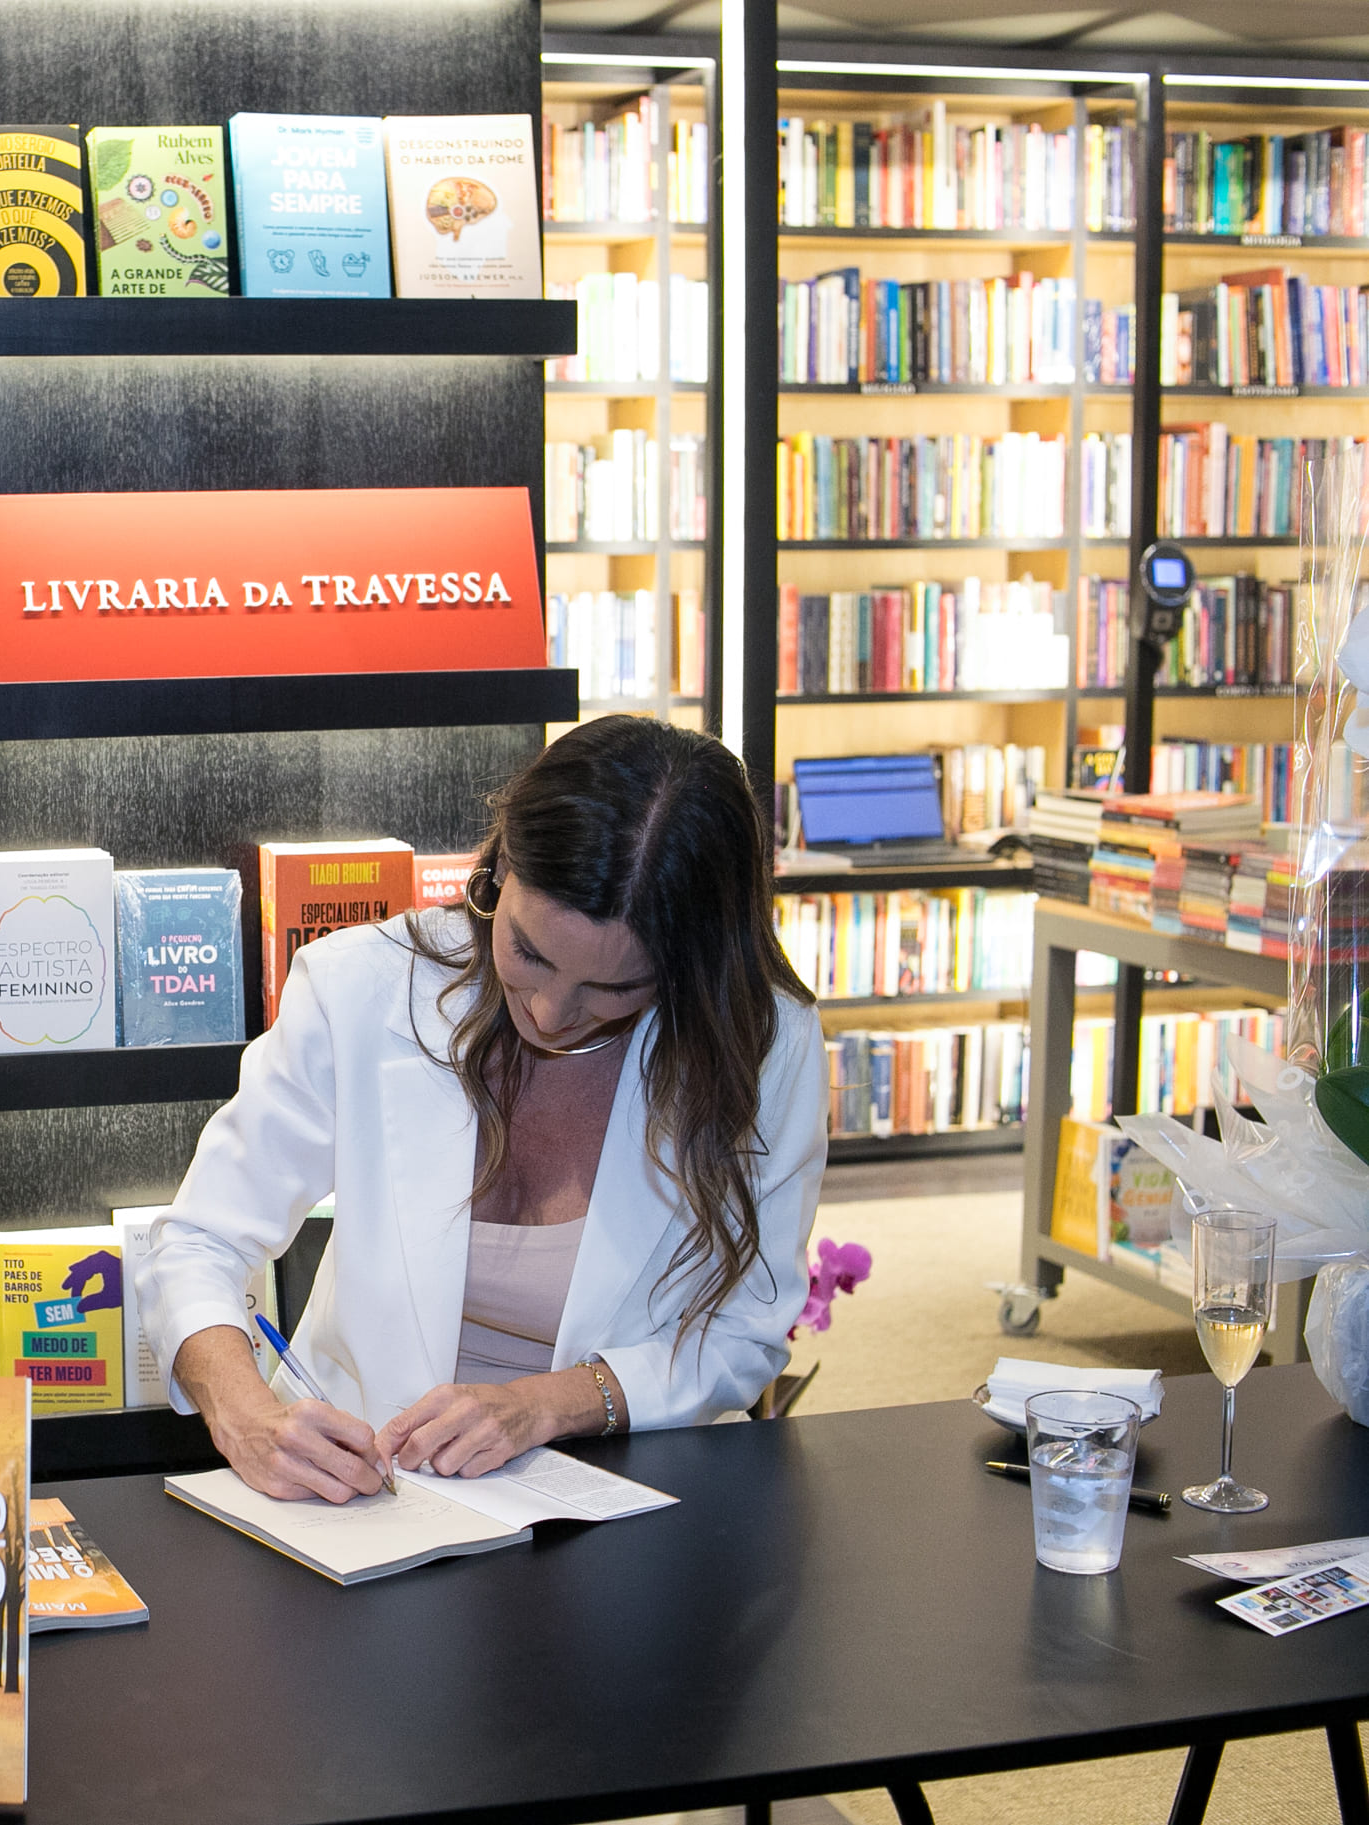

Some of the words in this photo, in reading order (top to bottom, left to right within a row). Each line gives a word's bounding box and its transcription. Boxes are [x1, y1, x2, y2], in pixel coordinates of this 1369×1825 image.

[158, 133, 213, 148] Rubem
[399, 138, 525, 150] DESCONSTRUINDO
[175, 151, 214, 164] Alves
[270, 146, 357, 169] JOVEM
[400, 155, 411, 165] O
[467, 155, 486, 165] DA
[489, 153, 525, 165] FOME
[283, 170, 347, 191] PARA
[17, 190, 74, 221] FAZEMOS
[270, 192, 363, 215] SEMPRE
[0, 210, 9, 225] O
[12, 210, 37, 225] QUE
[111, 269, 121, 279] A
[124, 268, 183, 280] GRANDE
[111, 283, 145, 294] ARTE
[149, 283, 166, 294] DE
[21, 577, 229, 613] LIVRARIA
[242, 580, 293, 608] DA
[301, 571, 512, 607] TRAVESSA
[309, 863, 340, 885] TIAGO
[342, 861, 381, 884] BRUNET
[422, 882, 457, 898] NÃO
[301, 902, 371, 925] ESPECIALISTA
[374, 900, 388, 921] EM
[169, 934, 202, 943] PEQUENO
[147, 945, 218, 965] LIVRO
[178, 965, 188, 974] DO
[150, 974, 215, 994] TDAH
[4, 1259, 24, 1268] TITO
[4, 1271, 28, 1280] PAES
[30, 1271, 42, 1281] DE
[4, 1283, 42, 1292] BARROS
[5, 1294, 29, 1303] NETO
[44, 1303, 75, 1323] SEM
[31, 1337, 68, 1353] MEDO
[71, 1337, 88, 1353] DE
[29, 1366, 52, 1381] TER
[55, 1366, 92, 1381] MEDO
[73, 1564, 94, 1578] O
[28, 1602, 87, 1611] MAIR
